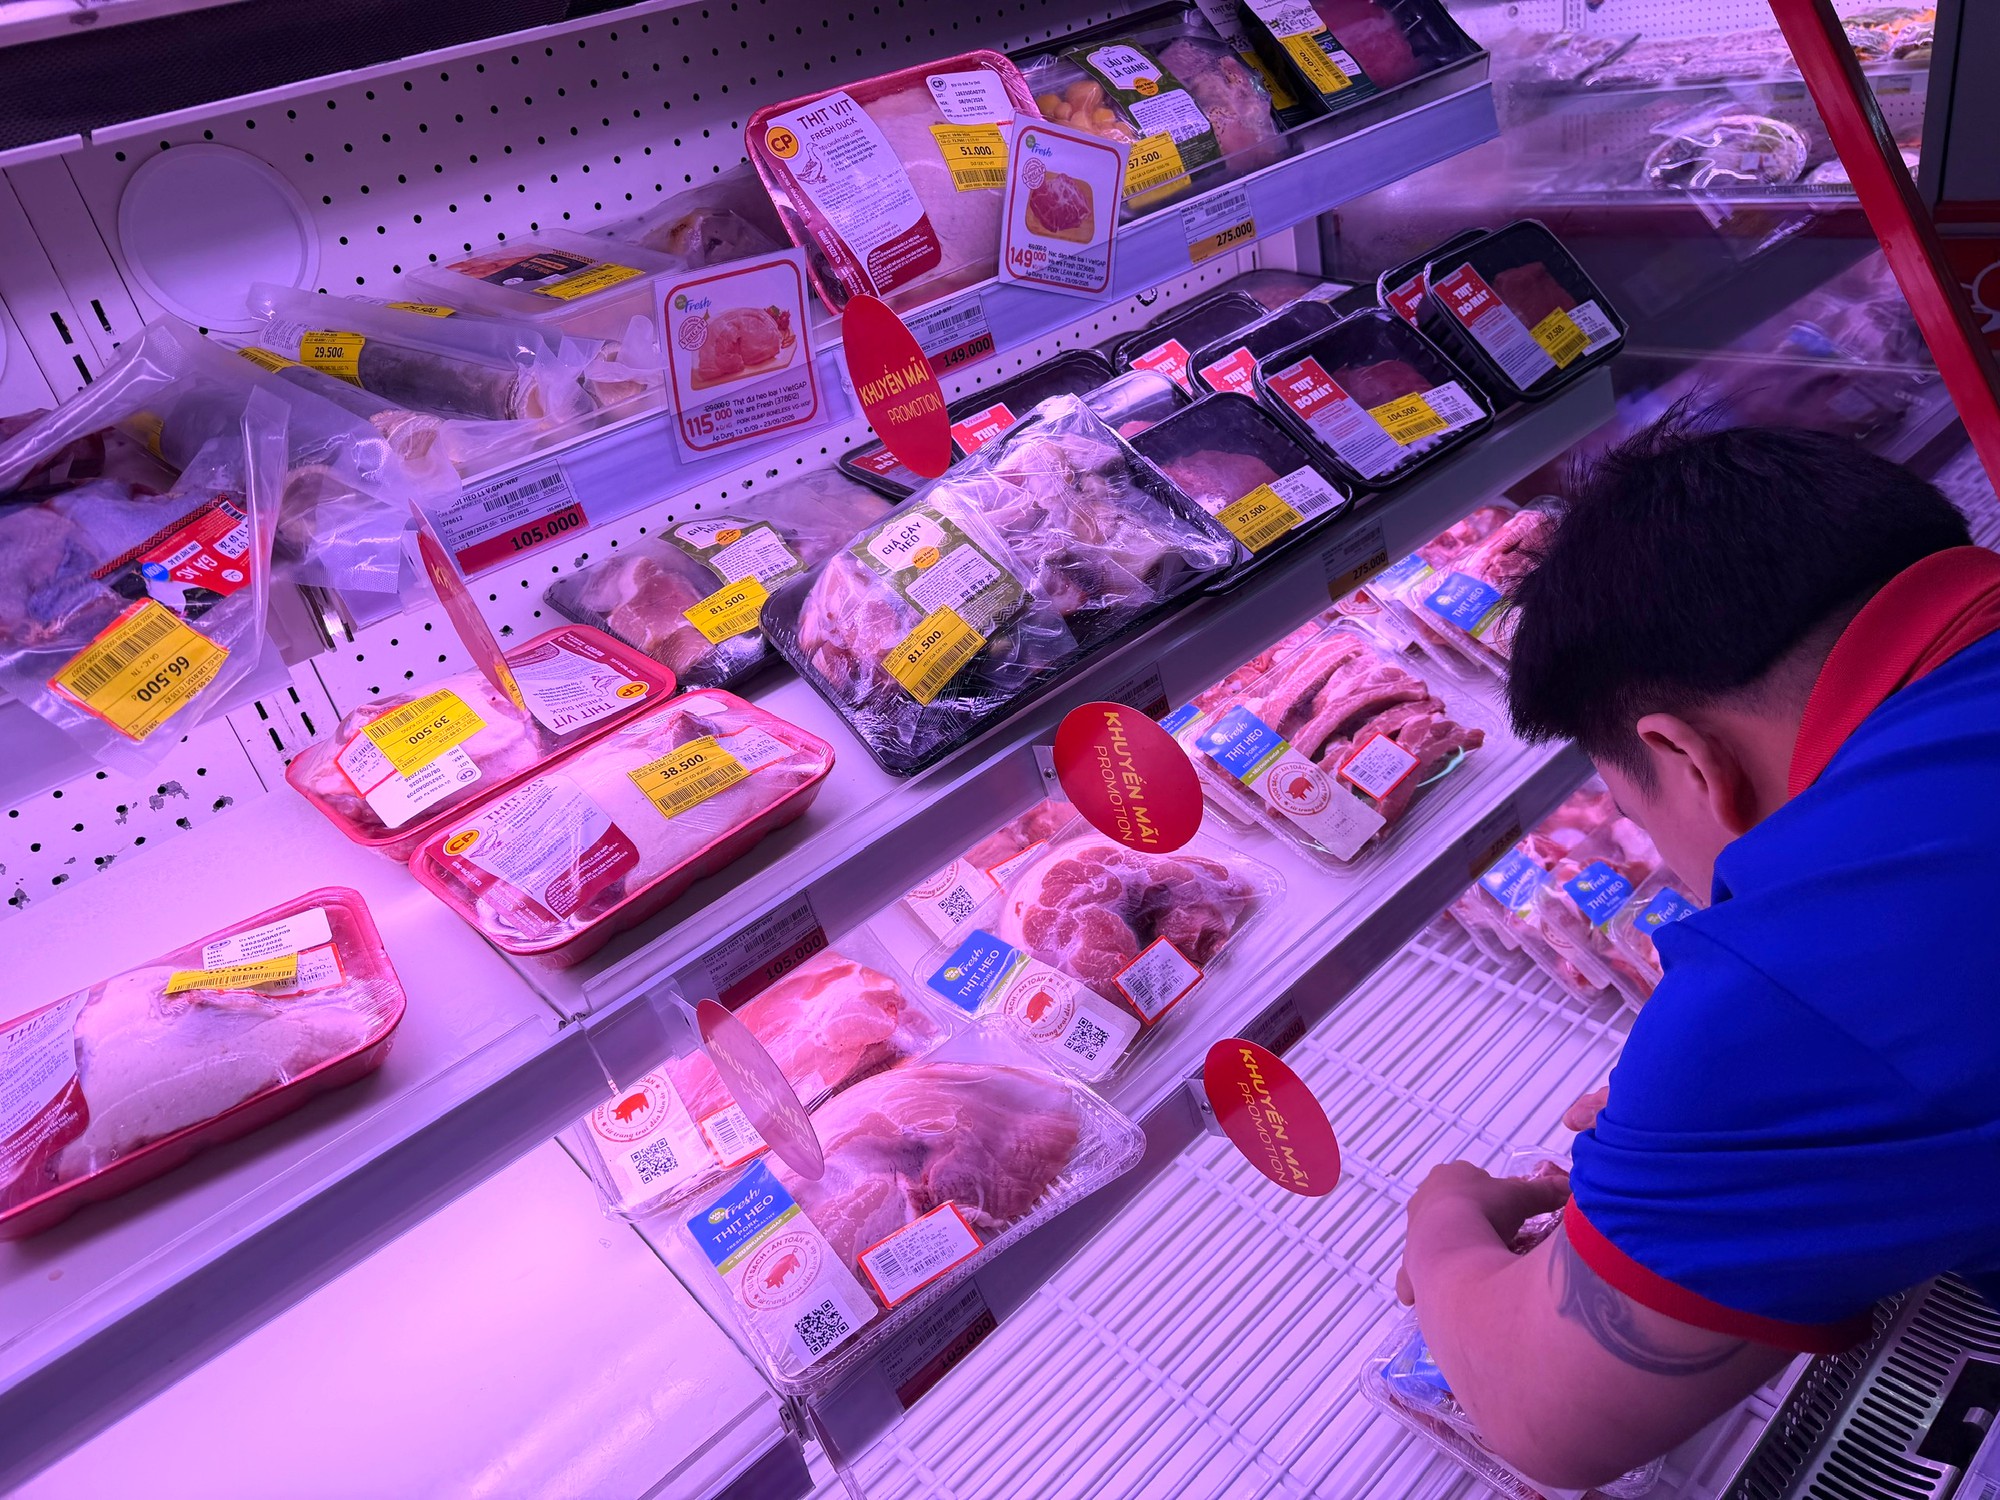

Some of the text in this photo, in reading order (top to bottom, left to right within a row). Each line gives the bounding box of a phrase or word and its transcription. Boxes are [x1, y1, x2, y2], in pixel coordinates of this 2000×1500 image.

[1103, 52, 1136, 70] LẨU GÀ
[1109, 60, 1148, 80] LÁ GIANG
[932, 80, 943, 88] CP
[797, 99, 853, 133] THỊT VỊT
[810, 115, 856, 141] FRESH DUCK
[770, 133, 793, 152] CP
[1214, 222, 1253, 246] 275.000
[1009, 247, 1046, 266] 149 000
[1452, 281, 1474, 302] THỊT
[1455, 287, 1490, 316] BÒ MÁT
[685, 297, 711, 312] Fresh
[943, 337, 990, 366] 149.000
[859, 357, 929, 405] KHUYẾN MÃI
[1224, 368, 1246, 383] THỊT
[1290, 377, 1313, 393] THỊT
[755, 391, 767, 400] heo
[783, 380, 807, 393] VietGAP
[1295, 394, 1311, 410] BÒ
[1311, 385, 1333, 402] MÁT
[734, 398, 773, 415] We are Fresh
[889, 393, 940, 425] PROMOTION
[686, 407, 732, 438] 115 000
[973, 423, 999, 441] THỊT
[462, 493, 477, 503] HEO
[500, 507, 528, 522] 23/09/2026
[1238, 503, 1266, 524] 97.500
[510, 511, 579, 551] 105.000
[898, 533, 920, 552] HEO
[880, 537, 901, 556] GIẢ
[175, 551, 219, 586] GÀ ÁC
[1354, 553, 1385, 579] 275.000
[709, 592, 745, 615] 81.500
[1450, 585, 1484, 619] THỊT HEO
[621, 682, 642, 697] CP
[549, 692, 602, 719] FRESH DUCK
[551, 696, 614, 729] THỊT VỊT
[1221, 719, 1249, 743] Fresh
[1224, 727, 1264, 763] THỊT HEO
[403, 761, 435, 782] 11/09/2026
[456, 758, 469, 770] LOT:
[458, 767, 474, 782] CP
[408, 767, 439, 788] 08/09/2026
[1104, 715, 1159, 843] KHUYẾN MÃI
[1095, 748, 1133, 839] PROMOTION
[447, 830, 477, 853] CP
[1587, 870, 1609, 891] Fresh
[1587, 879, 1623, 911] THỊT HEO
[1655, 899, 1679, 922] Fresh
[761, 934, 825, 980] 105.000
[955, 945, 987, 976] Fresh
[956, 947, 1002, 1000] THỊT HEO
[978, 969, 996, 986] PORK
[1002, 995, 1022, 1015] SẠCH
[1017, 981, 1029, 993] AN
[1240, 1051, 1287, 1137] KHUYẾN
[1281, 1147, 1308, 1187] MÃI
[1239, 1085, 1287, 1181] PROMOTION
[720, 1184, 764, 1220] Fresh
[711, 1194, 776, 1245] THỊT HEO
[736, 1218, 759, 1234] PORK
[725, 1212, 776, 1252] FRESH AND HEALTHY
[769, 1238, 784, 1252] AN
[934, 1317, 997, 1367] 105.000
